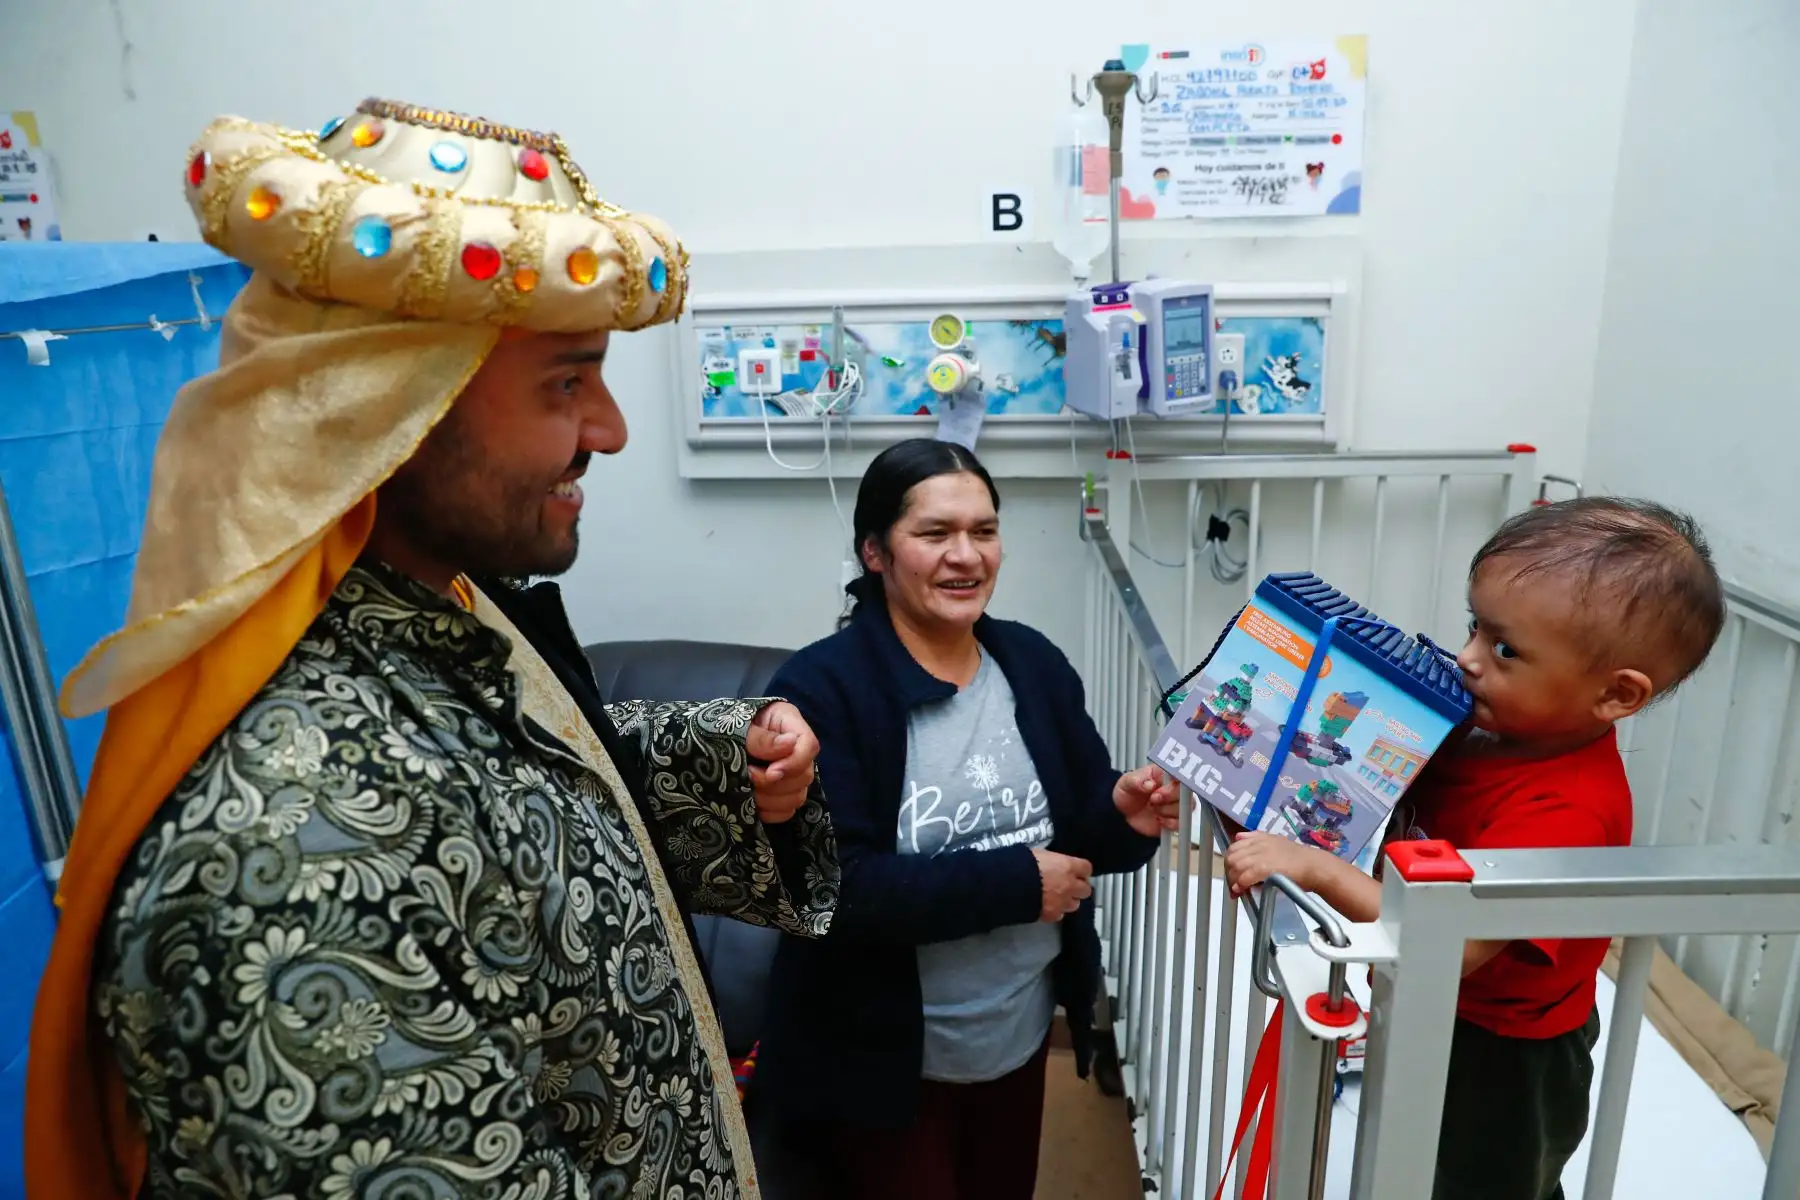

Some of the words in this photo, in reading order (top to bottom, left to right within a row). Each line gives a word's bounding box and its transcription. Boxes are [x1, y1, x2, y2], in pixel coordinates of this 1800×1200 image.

[1194, 163, 1213, 175] Hoy
[1215, 161, 1262, 173] cuidamos
[1264, 160, 1278, 171] de
[992, 194, 1023, 231] B
[897, 780, 983, 859] Be
